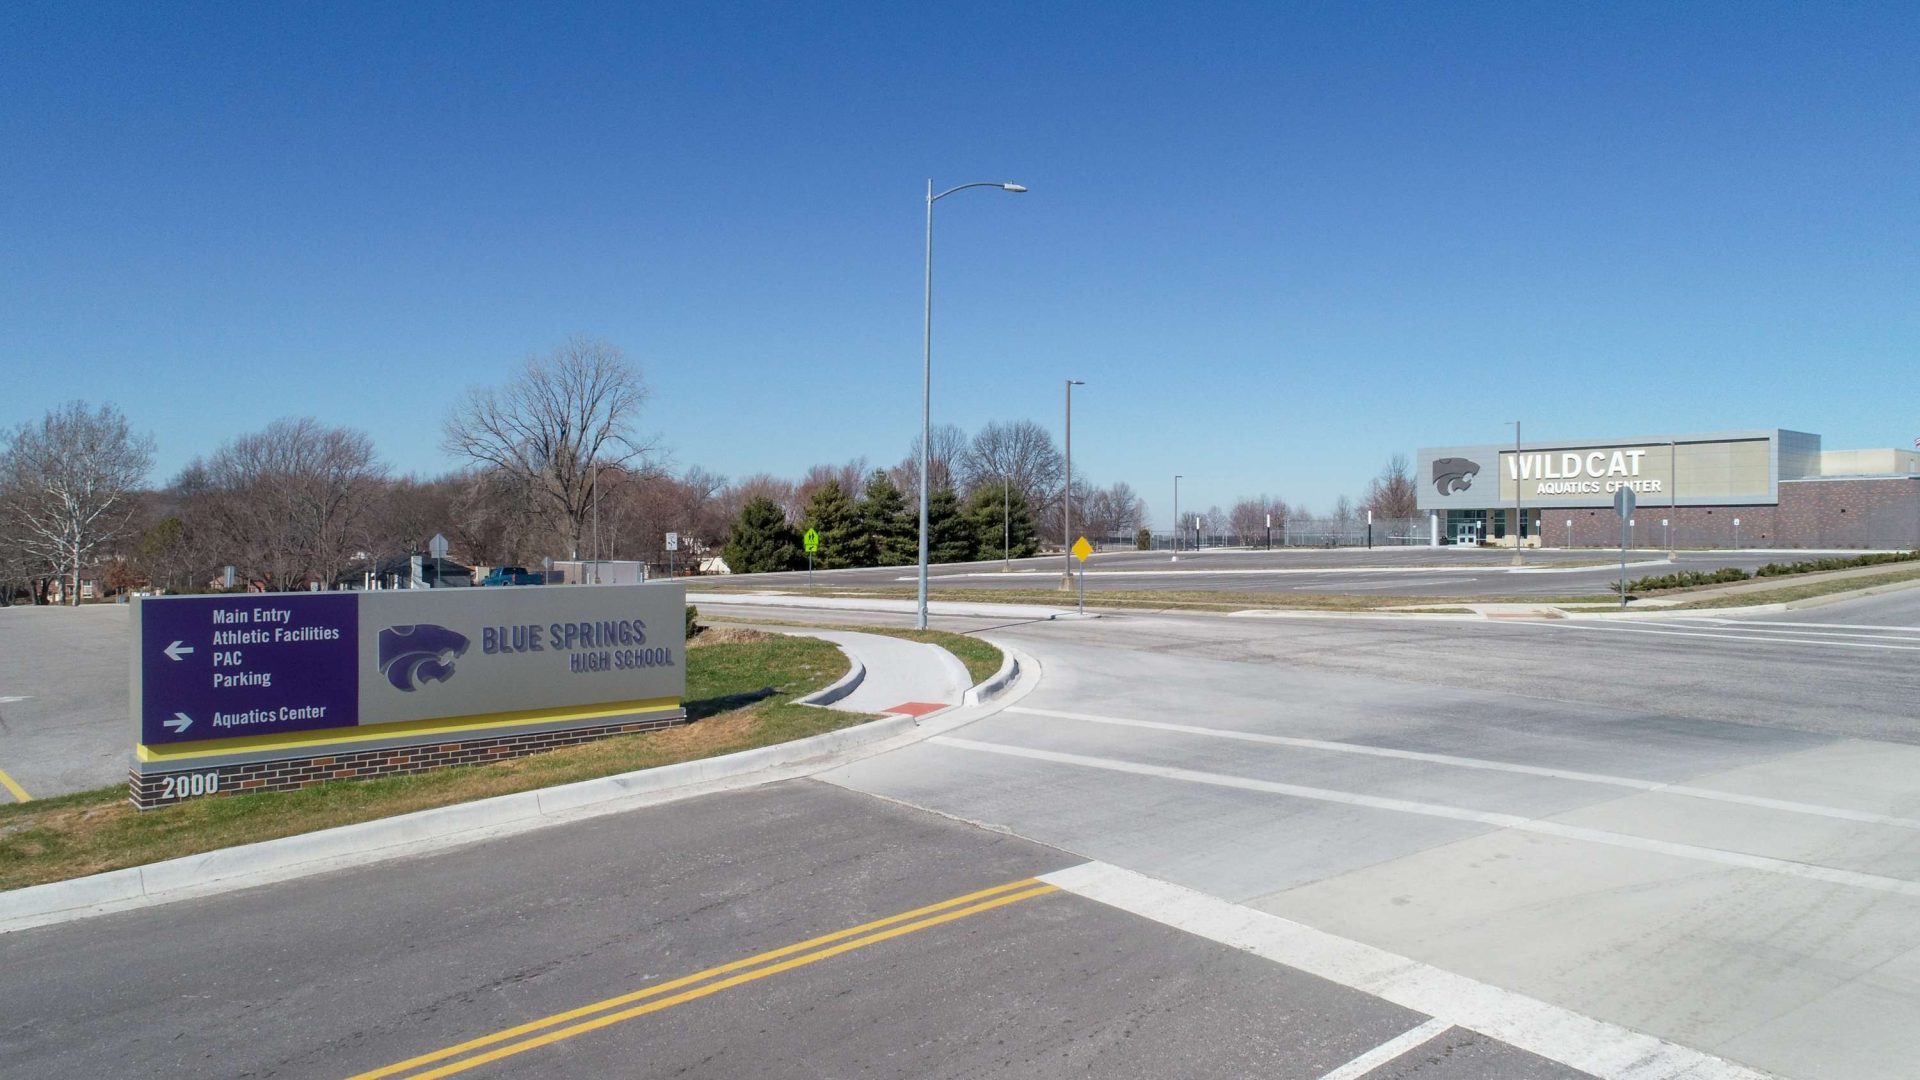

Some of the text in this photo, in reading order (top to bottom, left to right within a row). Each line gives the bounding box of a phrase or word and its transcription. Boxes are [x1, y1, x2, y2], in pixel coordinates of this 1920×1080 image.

[1508, 450, 1645, 480] WILDCAT
[1536, 481, 1600, 495] AQUATICS
[213, 608, 291, 624] Main Entry
[213, 626, 340, 645] Athletic Facilities
[483, 619, 647, 654] BLUE SPRINGS
[213, 651, 242, 667] PAC
[570, 647, 675, 673] HIGH SCHOOL
[213, 671, 272, 688] Parking
[212, 705, 327, 728] Aquatics Center
[161, 772, 219, 799] 2000
